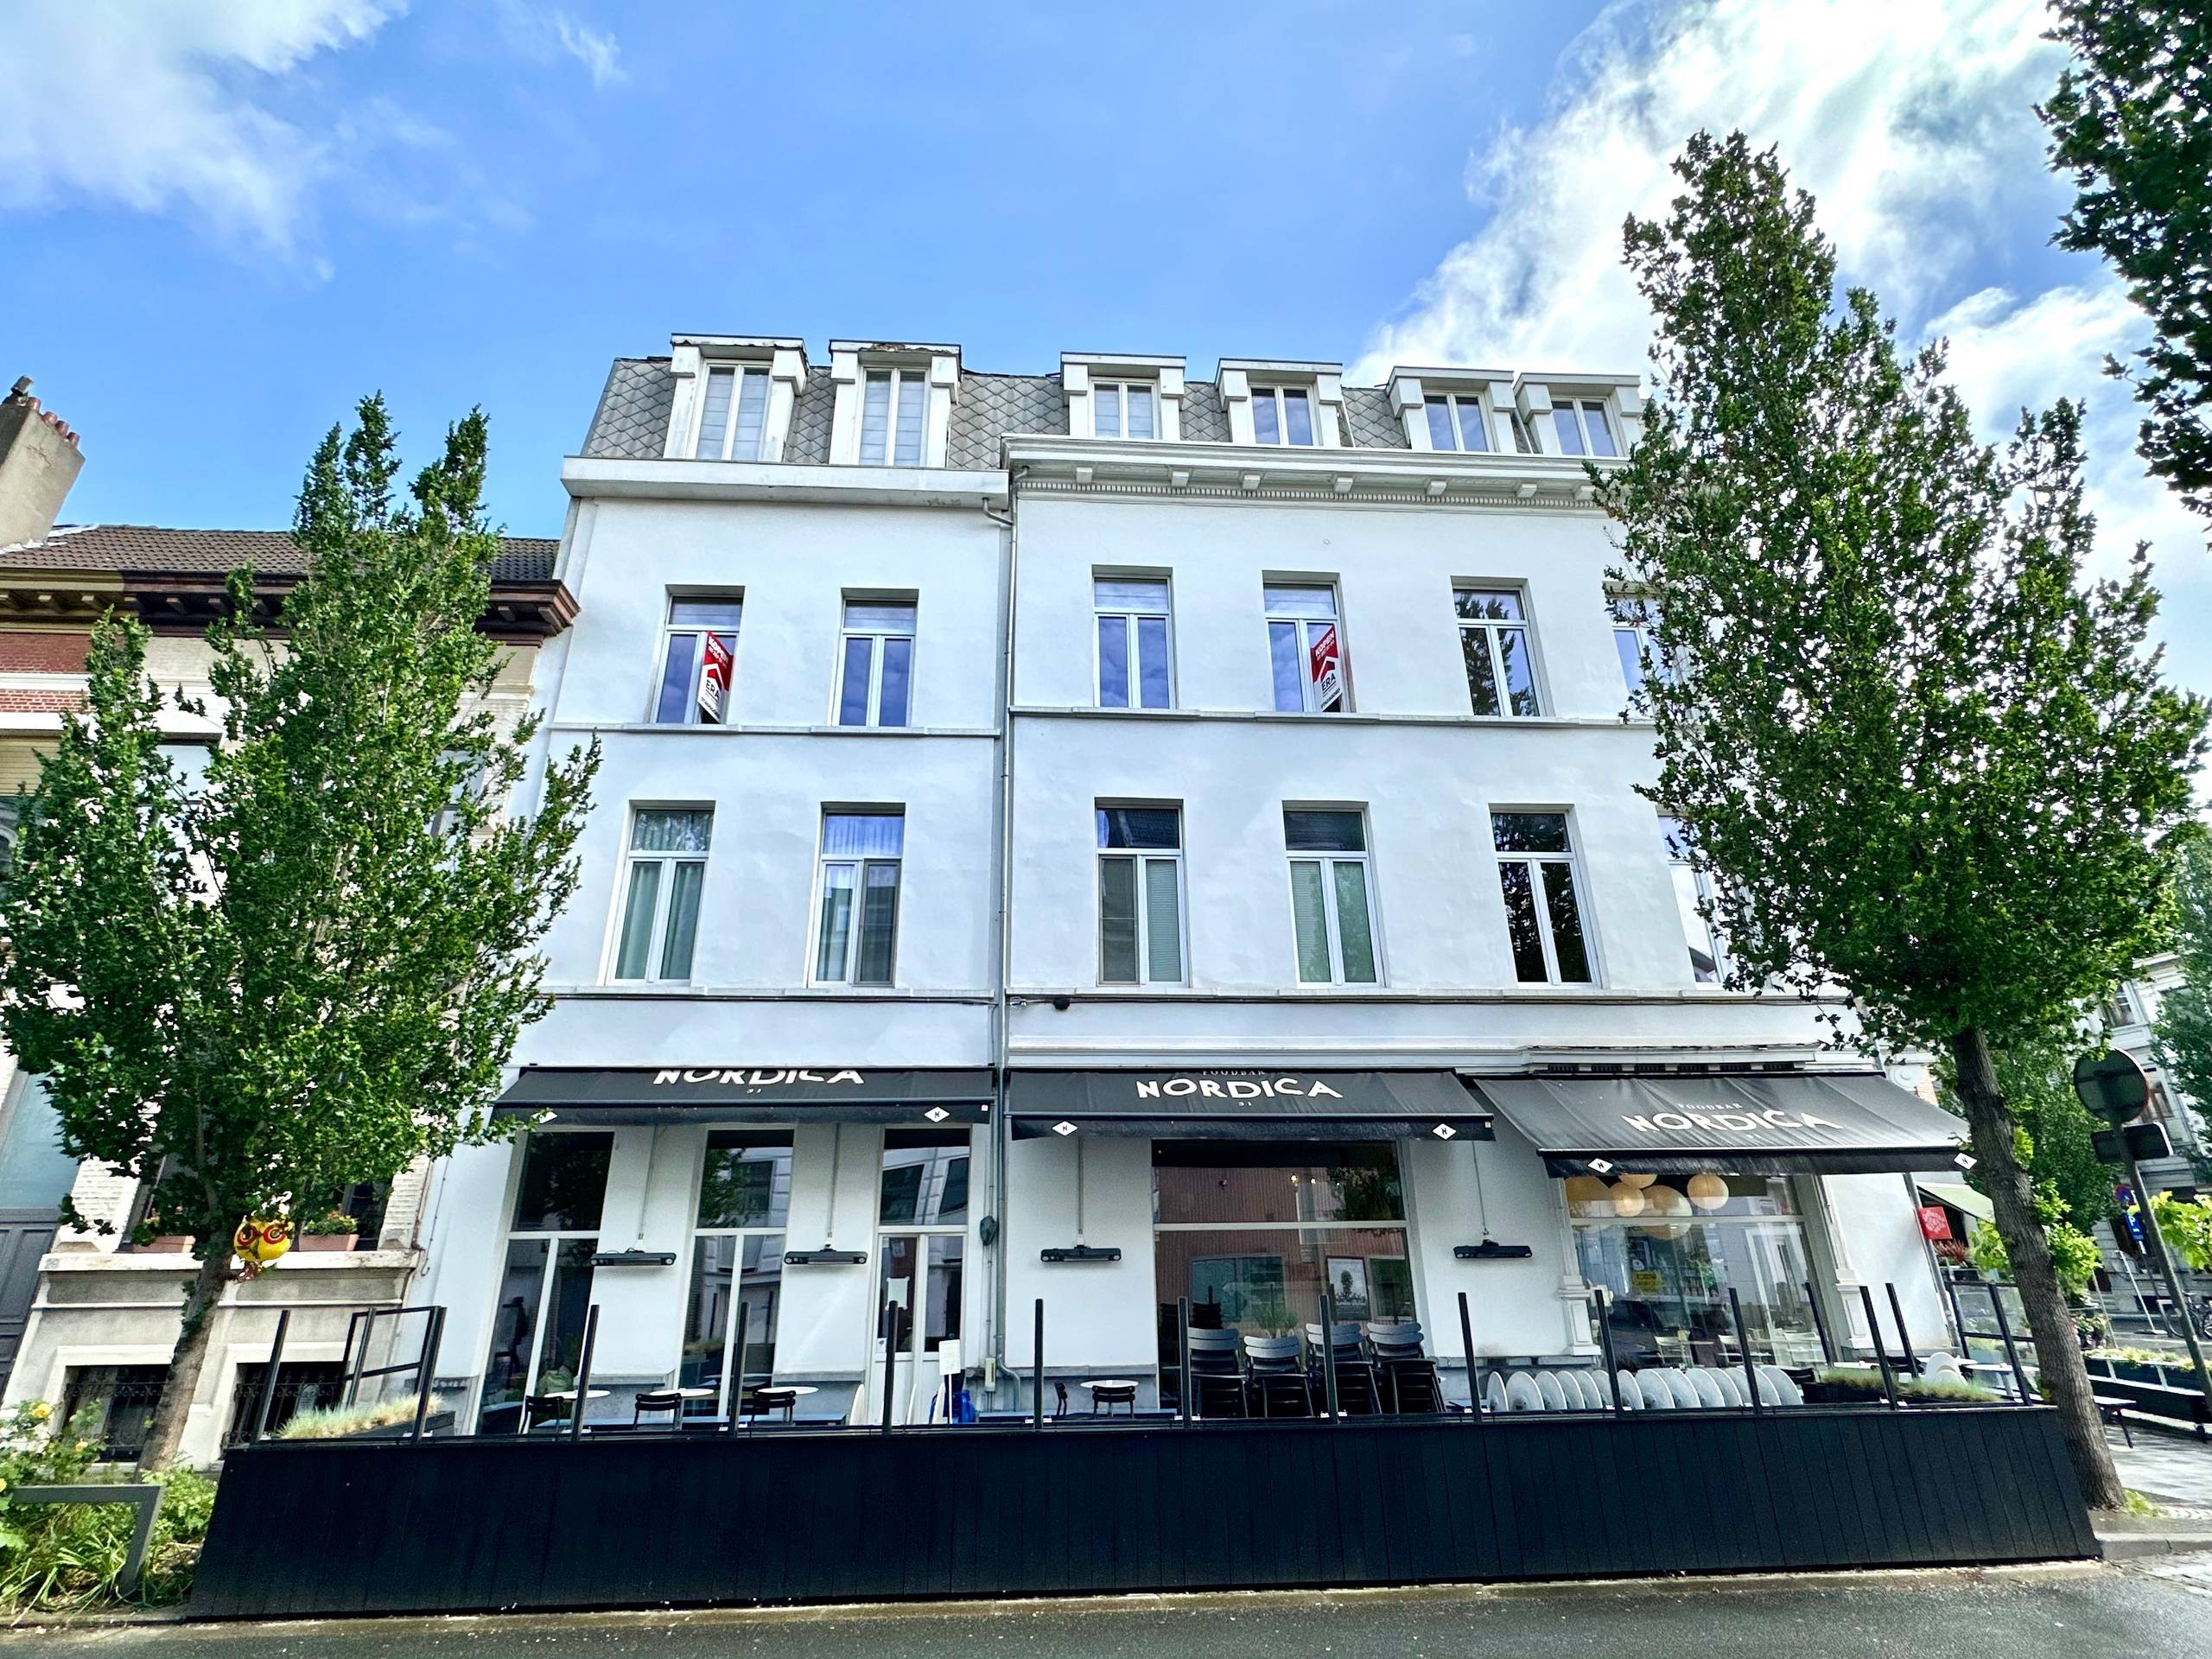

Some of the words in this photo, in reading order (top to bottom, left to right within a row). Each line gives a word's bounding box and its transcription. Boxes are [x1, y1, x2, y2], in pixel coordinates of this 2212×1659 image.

[1315, 630, 1335, 657] KOPEN
[705, 679, 720, 700] ERA
[1322, 673, 1336, 691] ERA
[1136, 1077, 1344, 1098] NORDICA
[1621, 1109, 1843, 1132] NORDICA
[2128, 1216, 2136, 1227] P
